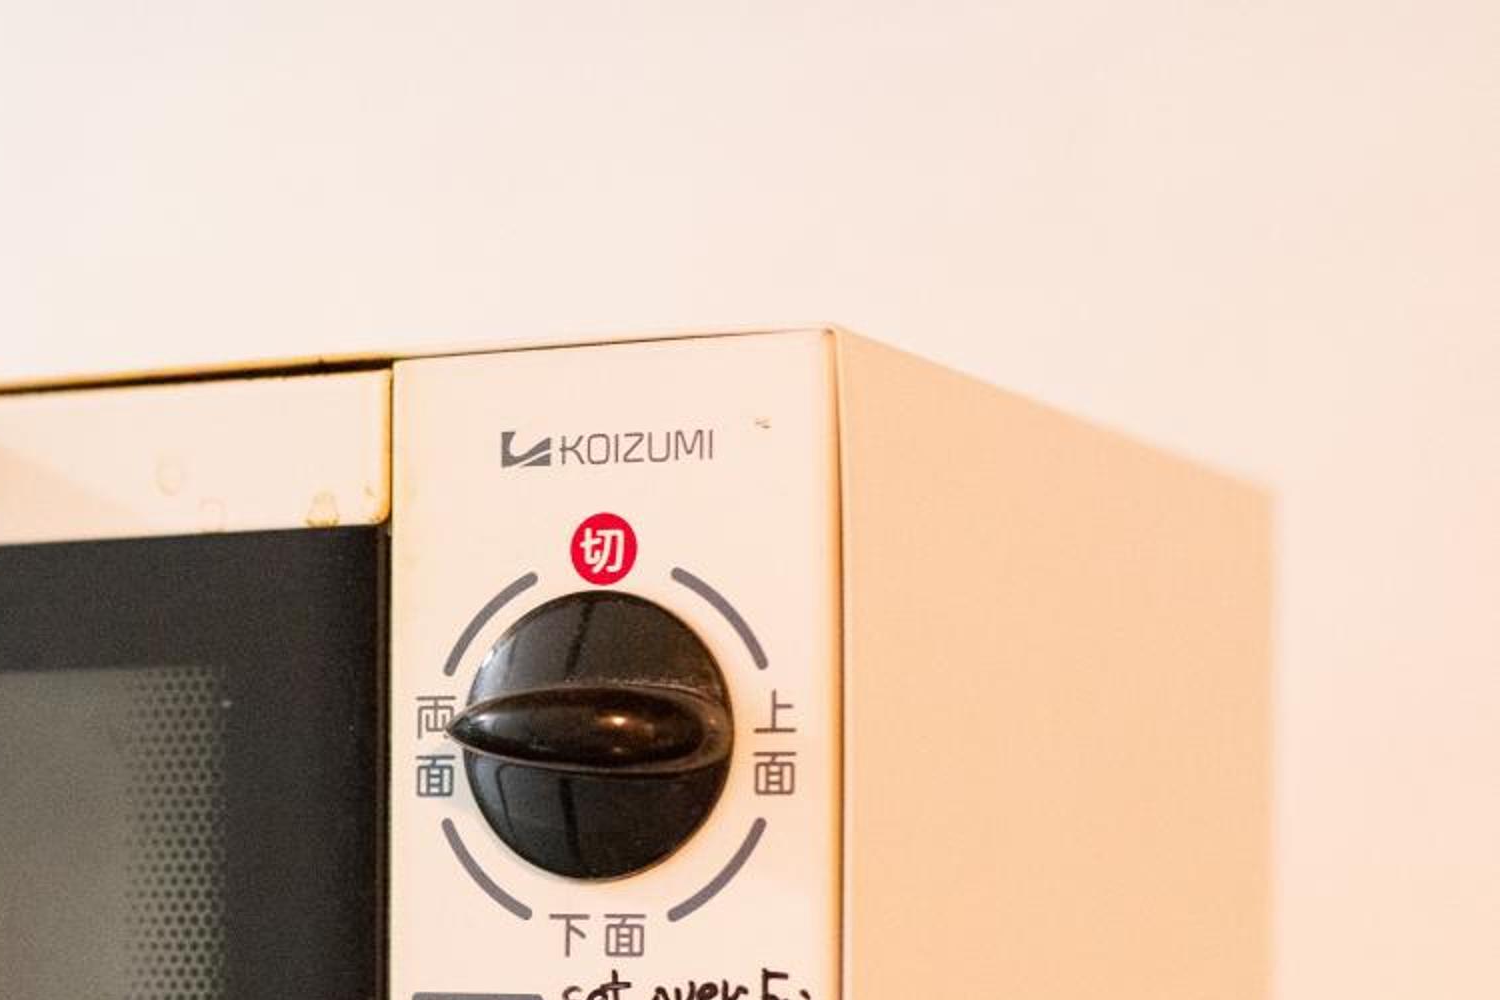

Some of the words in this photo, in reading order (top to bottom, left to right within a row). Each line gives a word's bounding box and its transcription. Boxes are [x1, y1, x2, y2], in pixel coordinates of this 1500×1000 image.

[560, 429, 715, 466] KOIZUMI
[579, 528, 625, 574] 切
[416, 695, 456, 797] 両面
[753, 690, 797, 796] 上面
[549, 914, 647, 958] 下面
